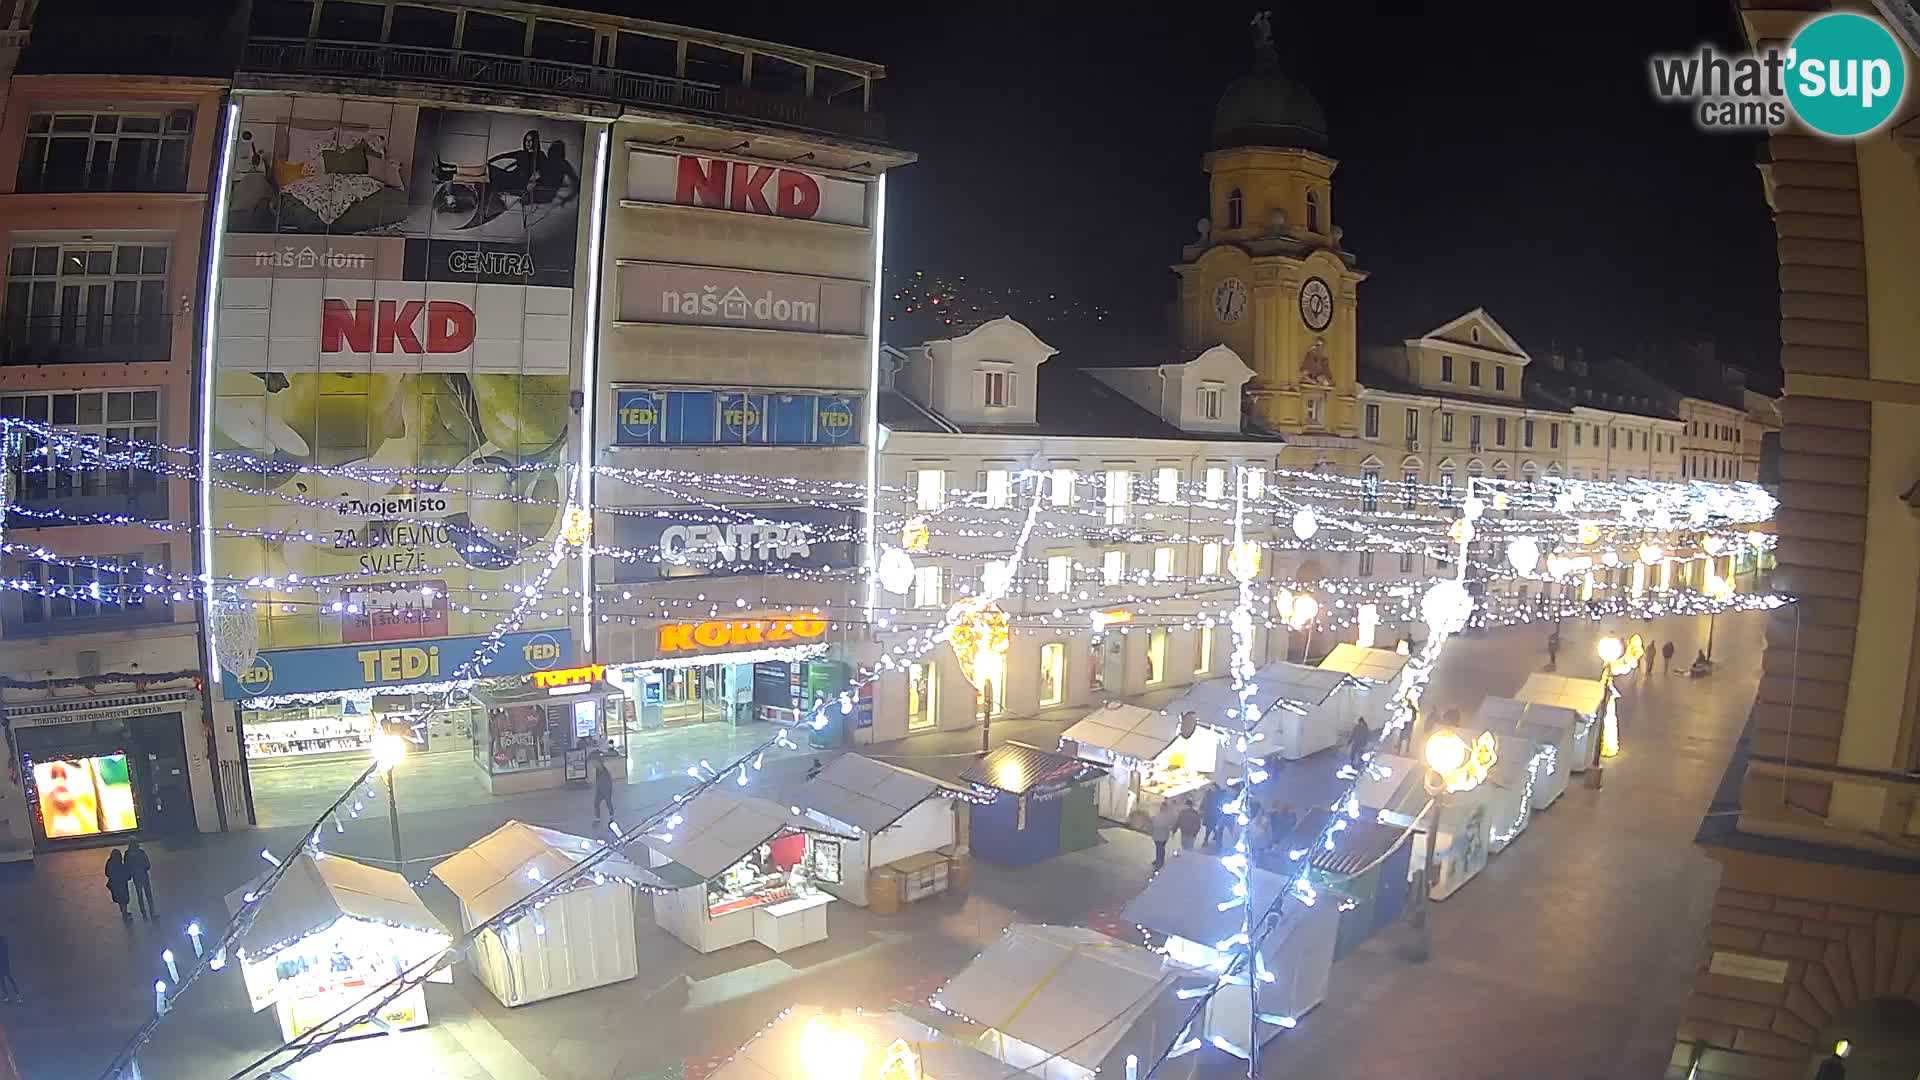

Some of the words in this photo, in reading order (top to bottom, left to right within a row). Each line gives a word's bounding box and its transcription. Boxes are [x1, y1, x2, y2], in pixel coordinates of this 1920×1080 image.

[675, 155, 821, 219] NKD
[255, 246, 295, 268] naš
[320, 249, 366, 269] dom
[449, 250, 535, 276] CENTRA
[661, 284, 718, 315] naš
[754, 291, 817, 323] dom
[321, 298, 477, 354] NKD
[619, 408, 658, 425] TEDi
[339, 497, 446, 515] #TvojeMisto
[334, 529, 358, 549] ZA
[367, 526, 450, 547] DNEVNO
[659, 521, 811, 562] CENTRA
[659, 613, 827, 652] KORZO
[358, 646, 441, 683] TEDi
[523, 643, 560, 660] TEDi
[534, 664, 606, 688] TOMMY
